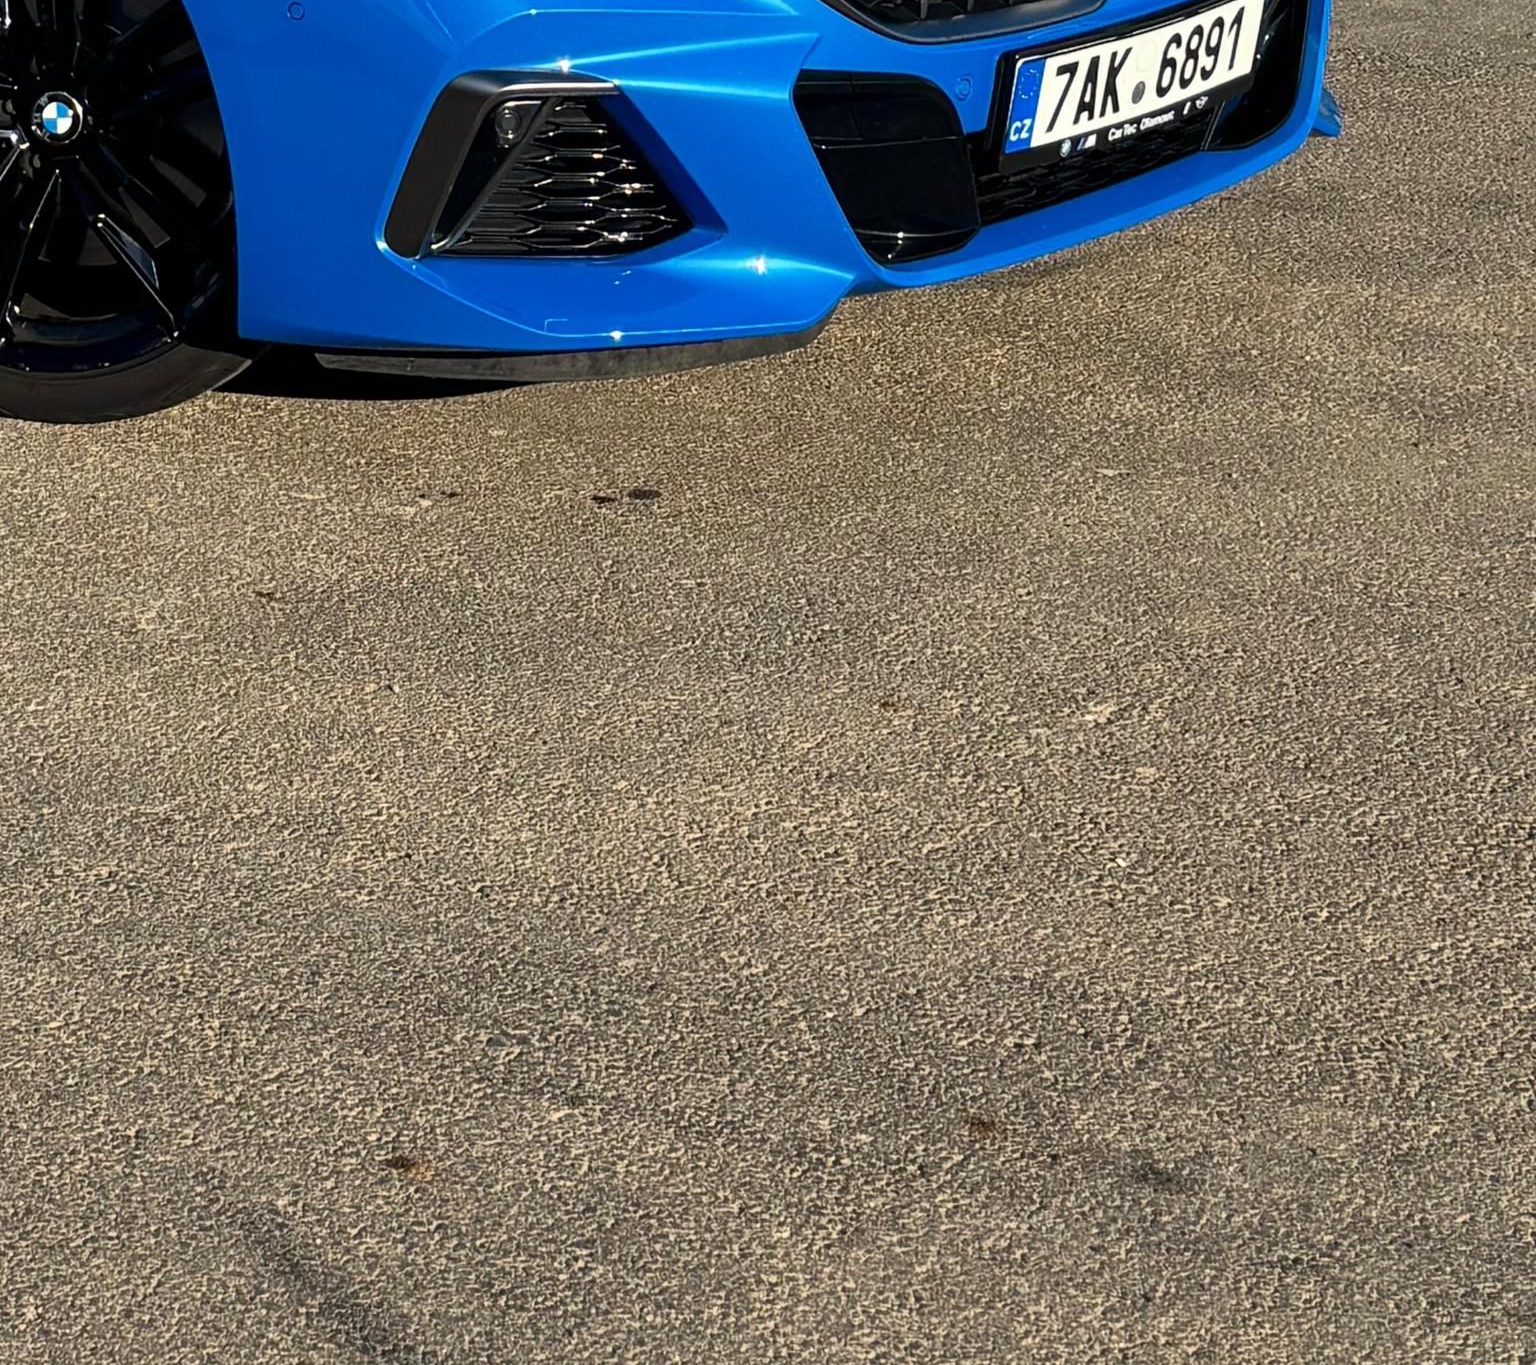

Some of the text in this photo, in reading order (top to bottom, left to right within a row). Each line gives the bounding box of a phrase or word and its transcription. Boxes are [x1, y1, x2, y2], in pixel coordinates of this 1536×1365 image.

[1045, 6, 1246, 134] 7AK 6891
[1009, 118, 1033, 142] CZ
